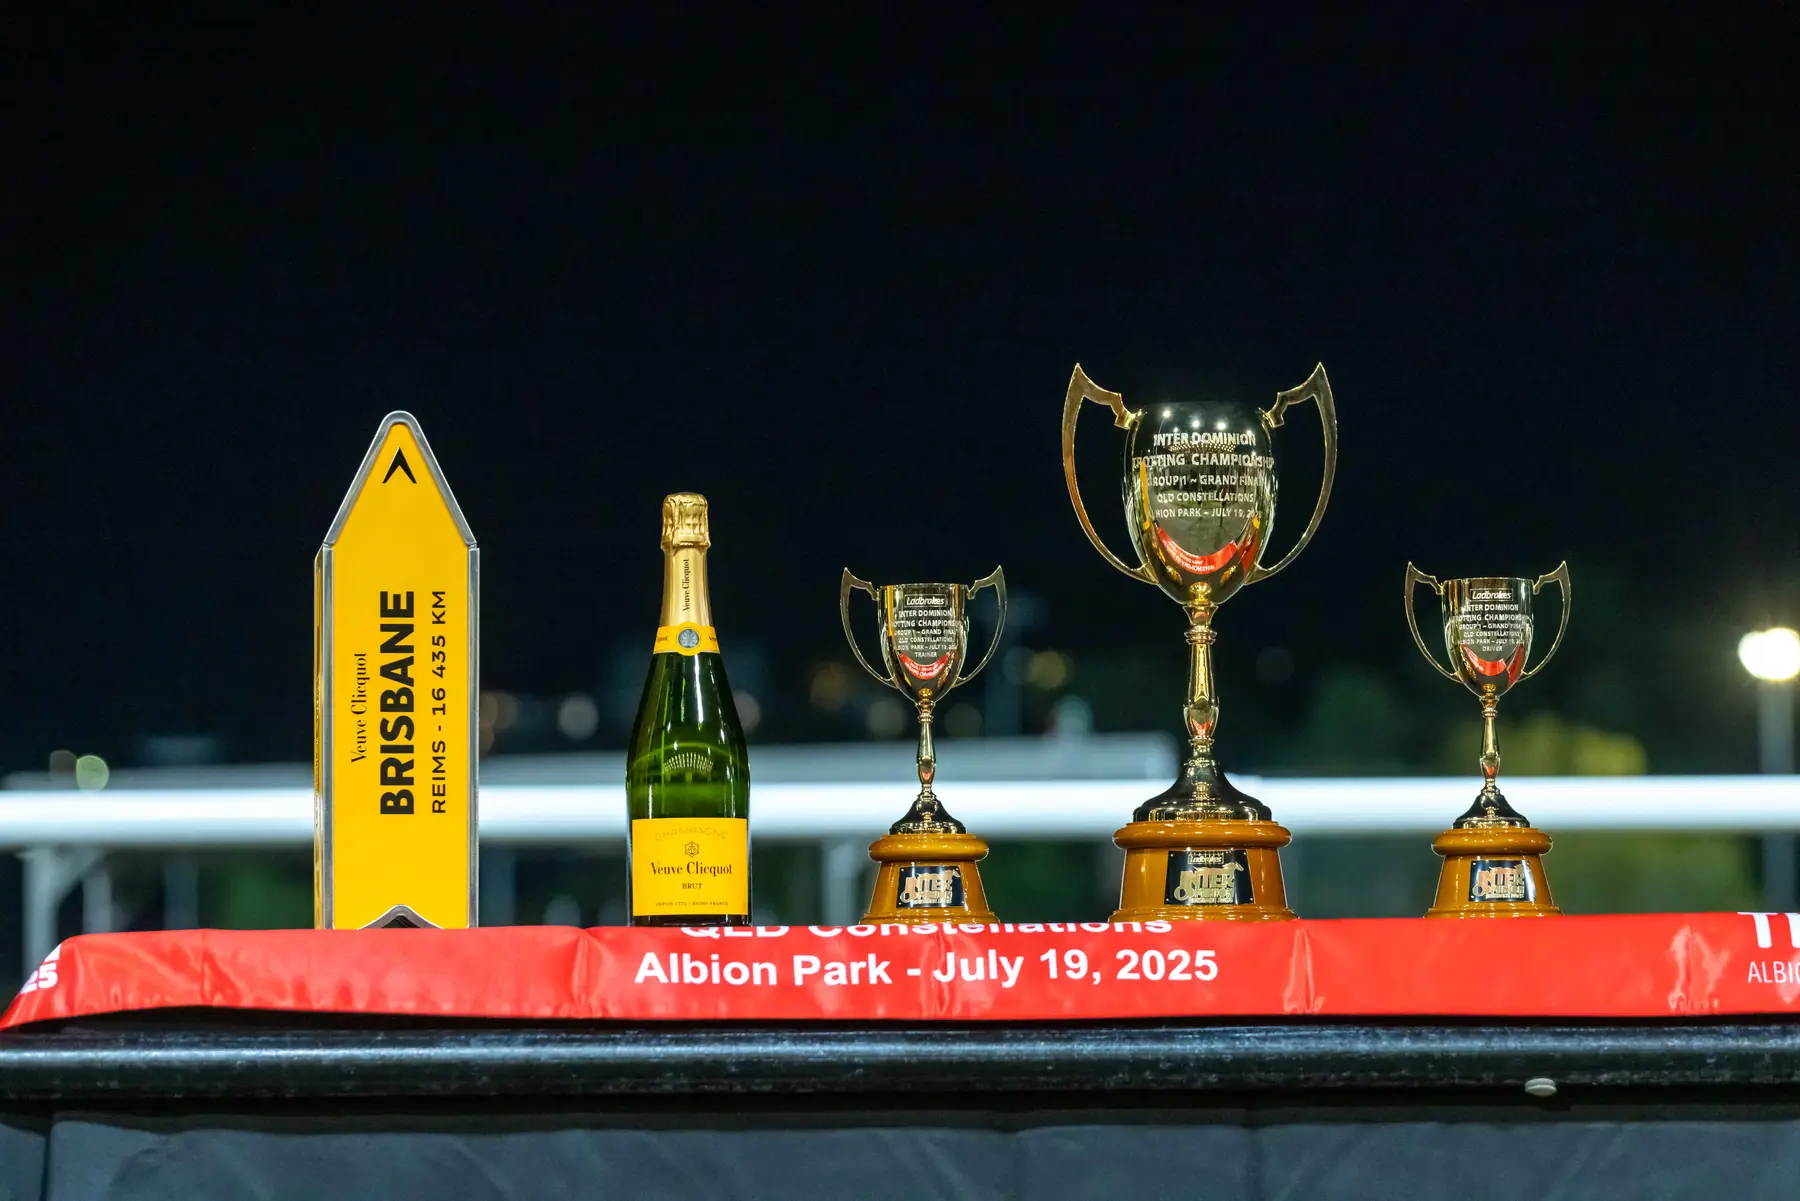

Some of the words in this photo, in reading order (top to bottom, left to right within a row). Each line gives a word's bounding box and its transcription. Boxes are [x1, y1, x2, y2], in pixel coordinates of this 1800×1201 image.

[1153, 433, 1189, 446] INTER
[1191, 432, 1256, 446] DOMINION
[1200, 474, 1236, 486] GRAND
[1176, 491, 1254, 503] CONSTELLATIONS
[1177, 507, 1202, 517] PARK
[1211, 506, 1232, 517] JULY
[681, 559, 691, 589] Clicquot
[681, 590, 690, 611] Veuve
[906, 596, 945, 606] Ladbrokes
[1472, 590, 1512, 600] Ladbrokes
[432, 591, 446, 625] KM
[918, 609, 953, 617] DOMINION
[1484, 603, 1519, 611] DOMINION
[432, 635, 446, 678] 435
[351, 653, 370, 715] Clicquot
[380, 591, 414, 814] BRISBANE
[432, 687, 446, 715] 16
[351, 719, 367, 763] Veuve
[432, 740, 446, 814] REIMS
[651, 862, 683, 875] Veuve
[686, 861, 733, 877] Clicquot
[634, 952, 777, 986] Albion
[793, 953, 893, 986] Park
[933, 949, 1024, 988] July
[1040, 948, 1101, 985] 19,
[1116, 949, 1219, 981] 2025
